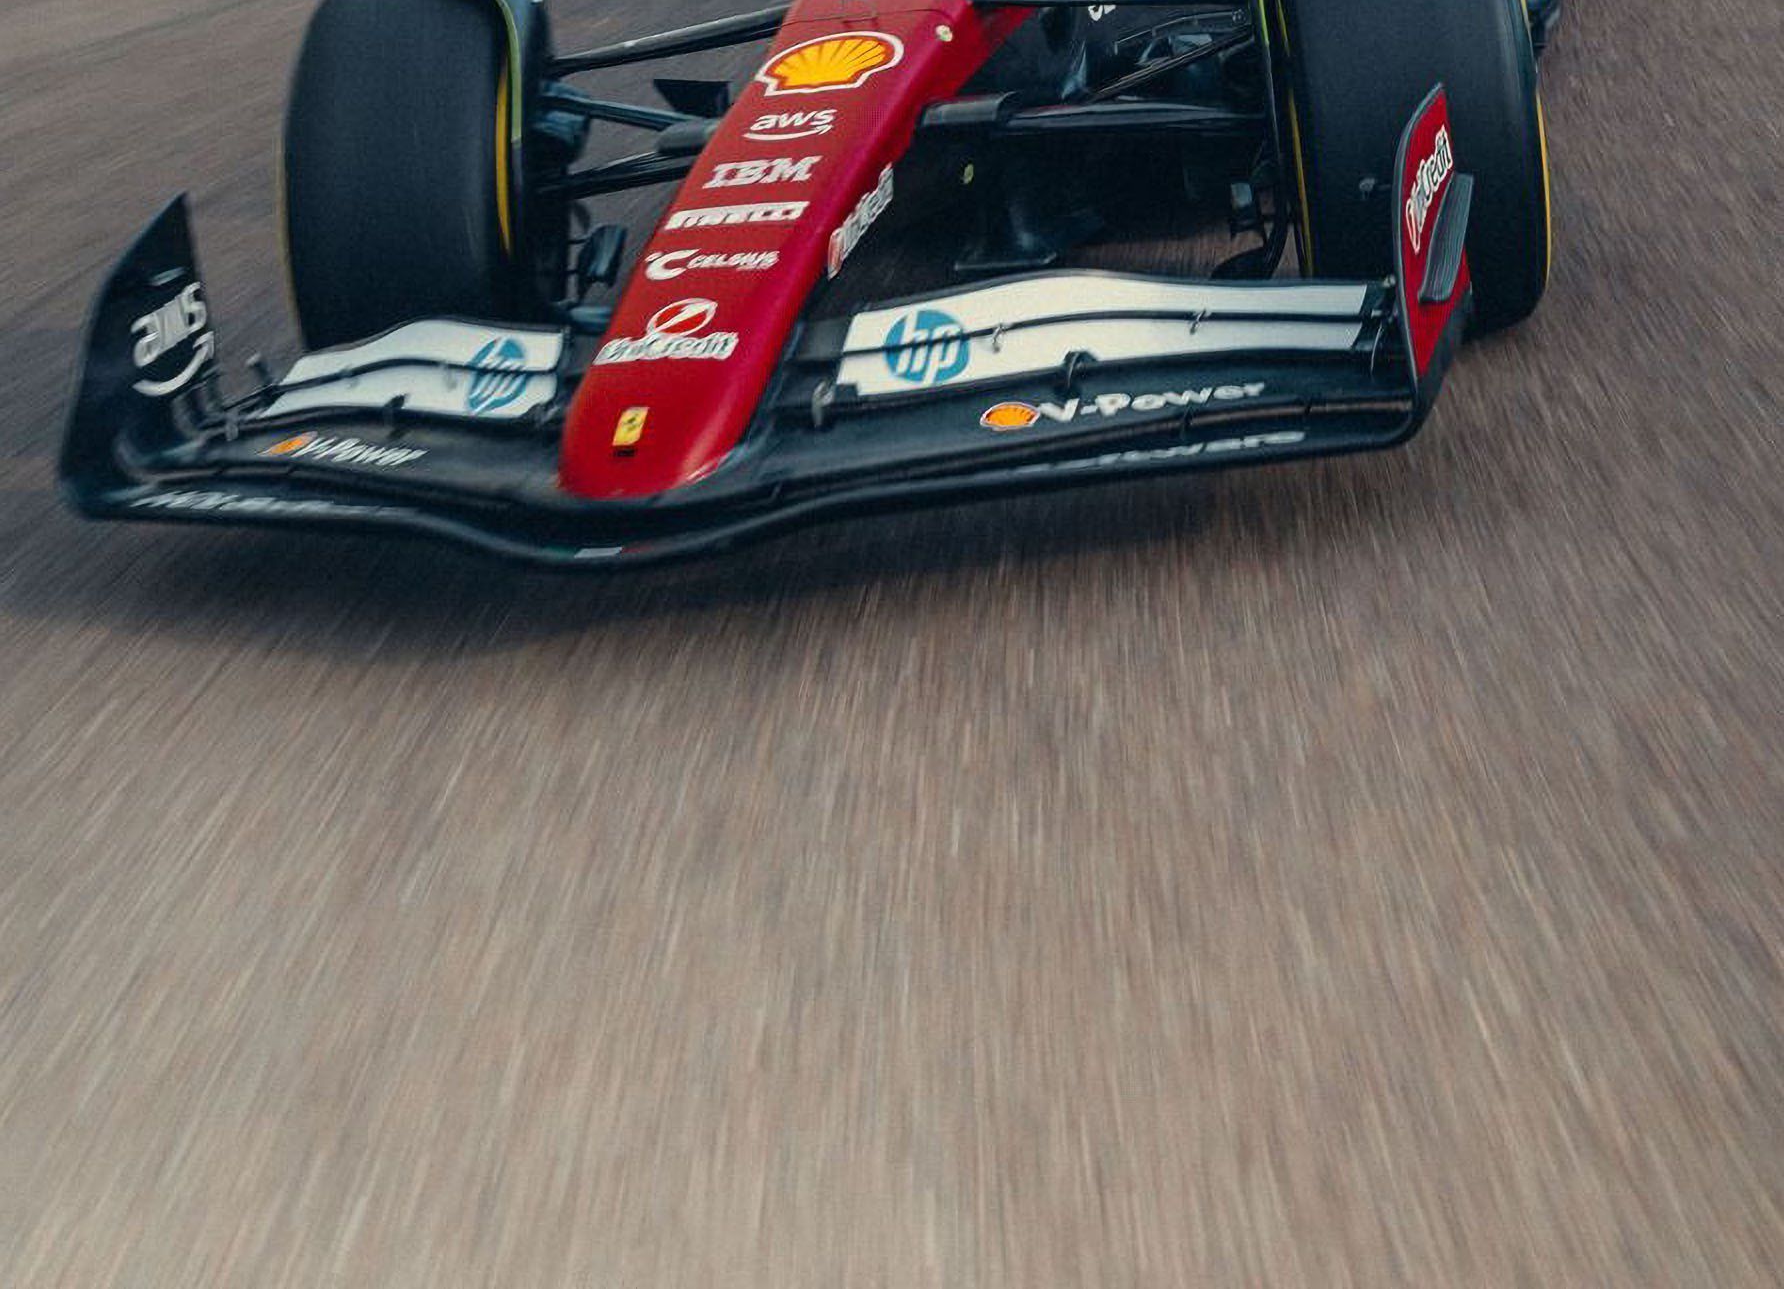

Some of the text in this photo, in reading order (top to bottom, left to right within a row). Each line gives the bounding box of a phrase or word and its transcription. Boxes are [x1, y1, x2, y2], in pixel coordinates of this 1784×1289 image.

[749, 108, 838, 132] aws
[701, 155, 824, 190] IBM
[887, 309, 968, 386] hp
[1037, 381, 1266, 422] V-Power
